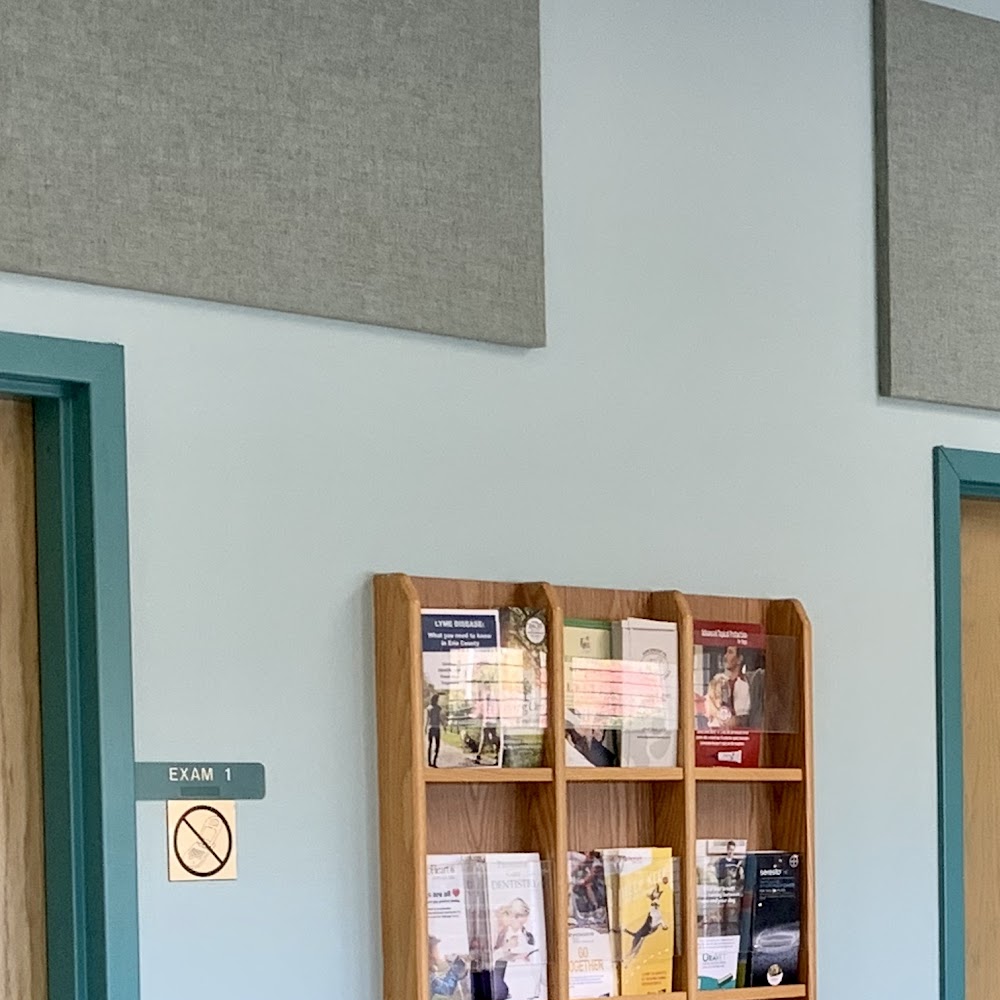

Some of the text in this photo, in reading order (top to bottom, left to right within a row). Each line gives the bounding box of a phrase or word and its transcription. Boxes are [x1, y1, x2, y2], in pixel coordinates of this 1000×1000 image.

[434, 620, 453, 628] LYME
[168, 767, 231, 781] EXAM 1
